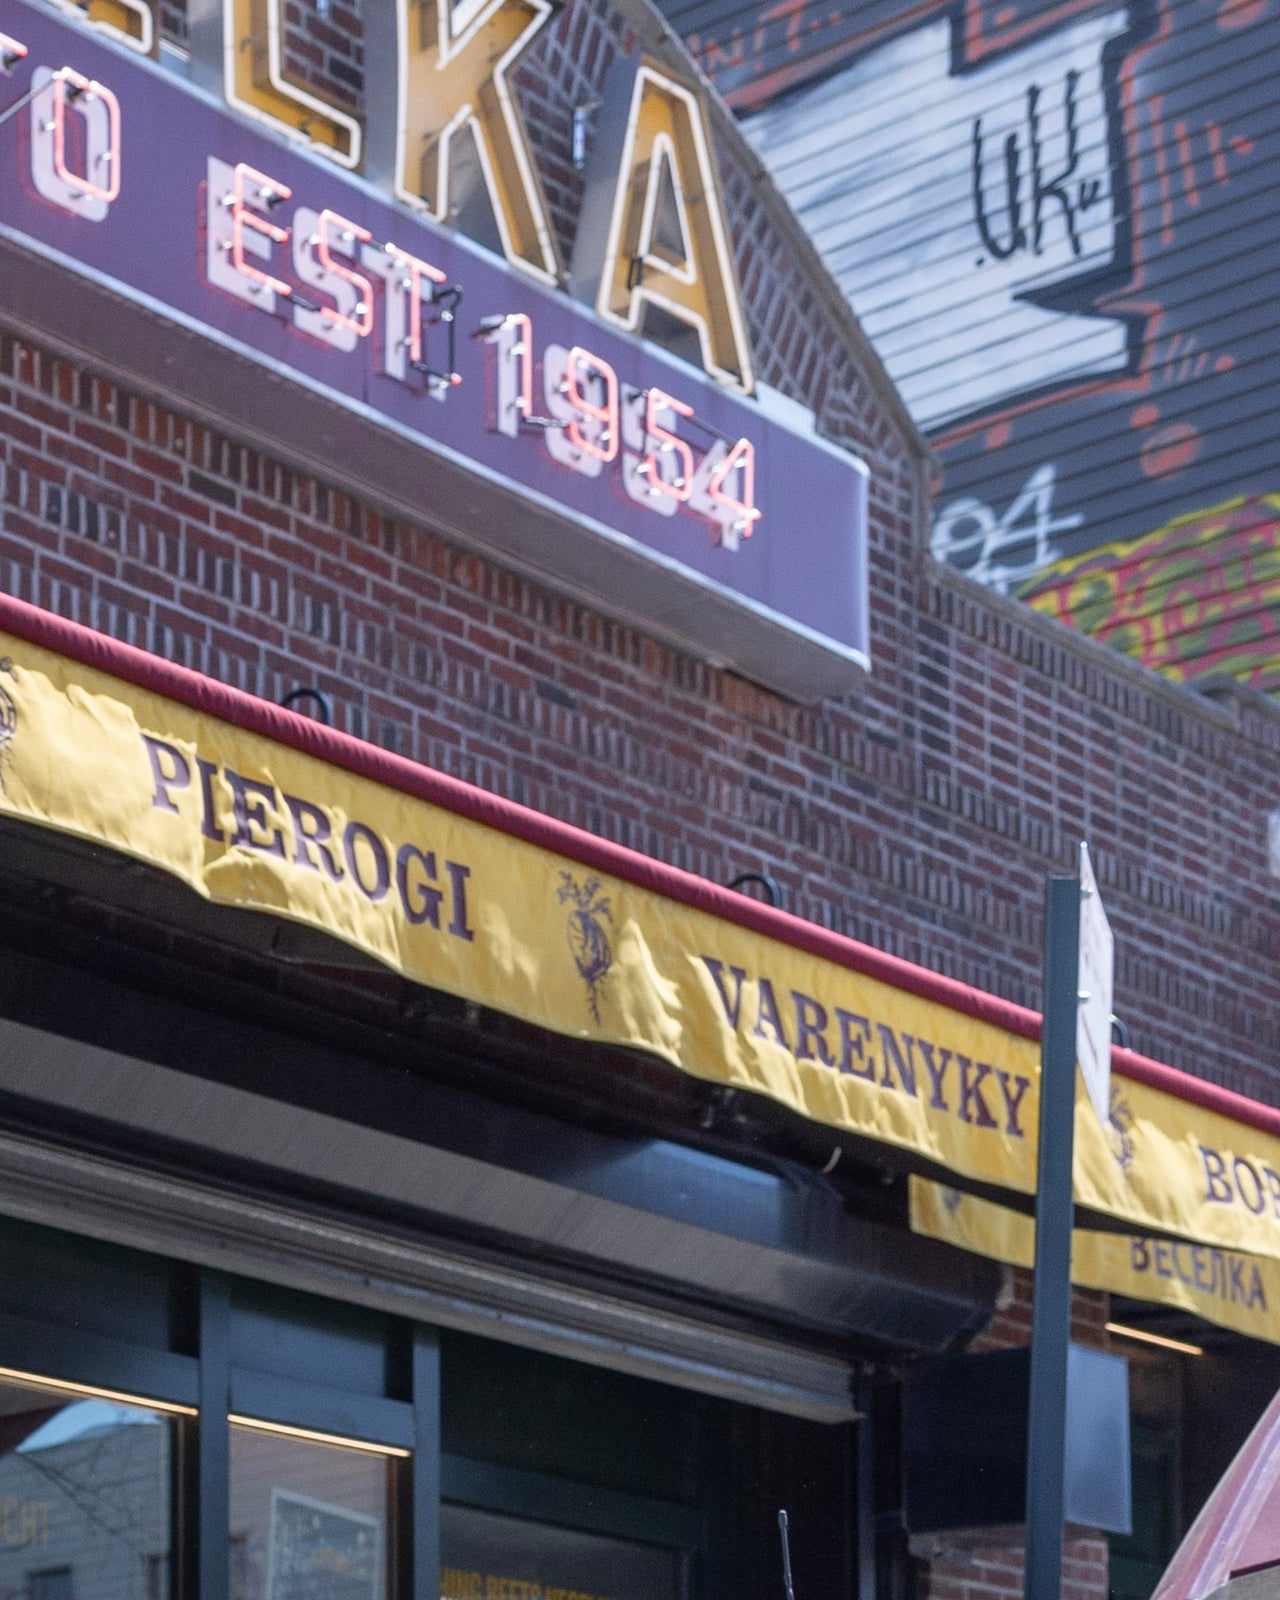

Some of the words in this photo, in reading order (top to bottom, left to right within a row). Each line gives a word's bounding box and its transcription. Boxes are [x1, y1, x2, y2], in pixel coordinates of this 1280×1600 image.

[478, 314, 762, 552] 1954
[140, 733, 474, 942] PIEROGI
[701, 955, 1031, 1138] VARENYKY
